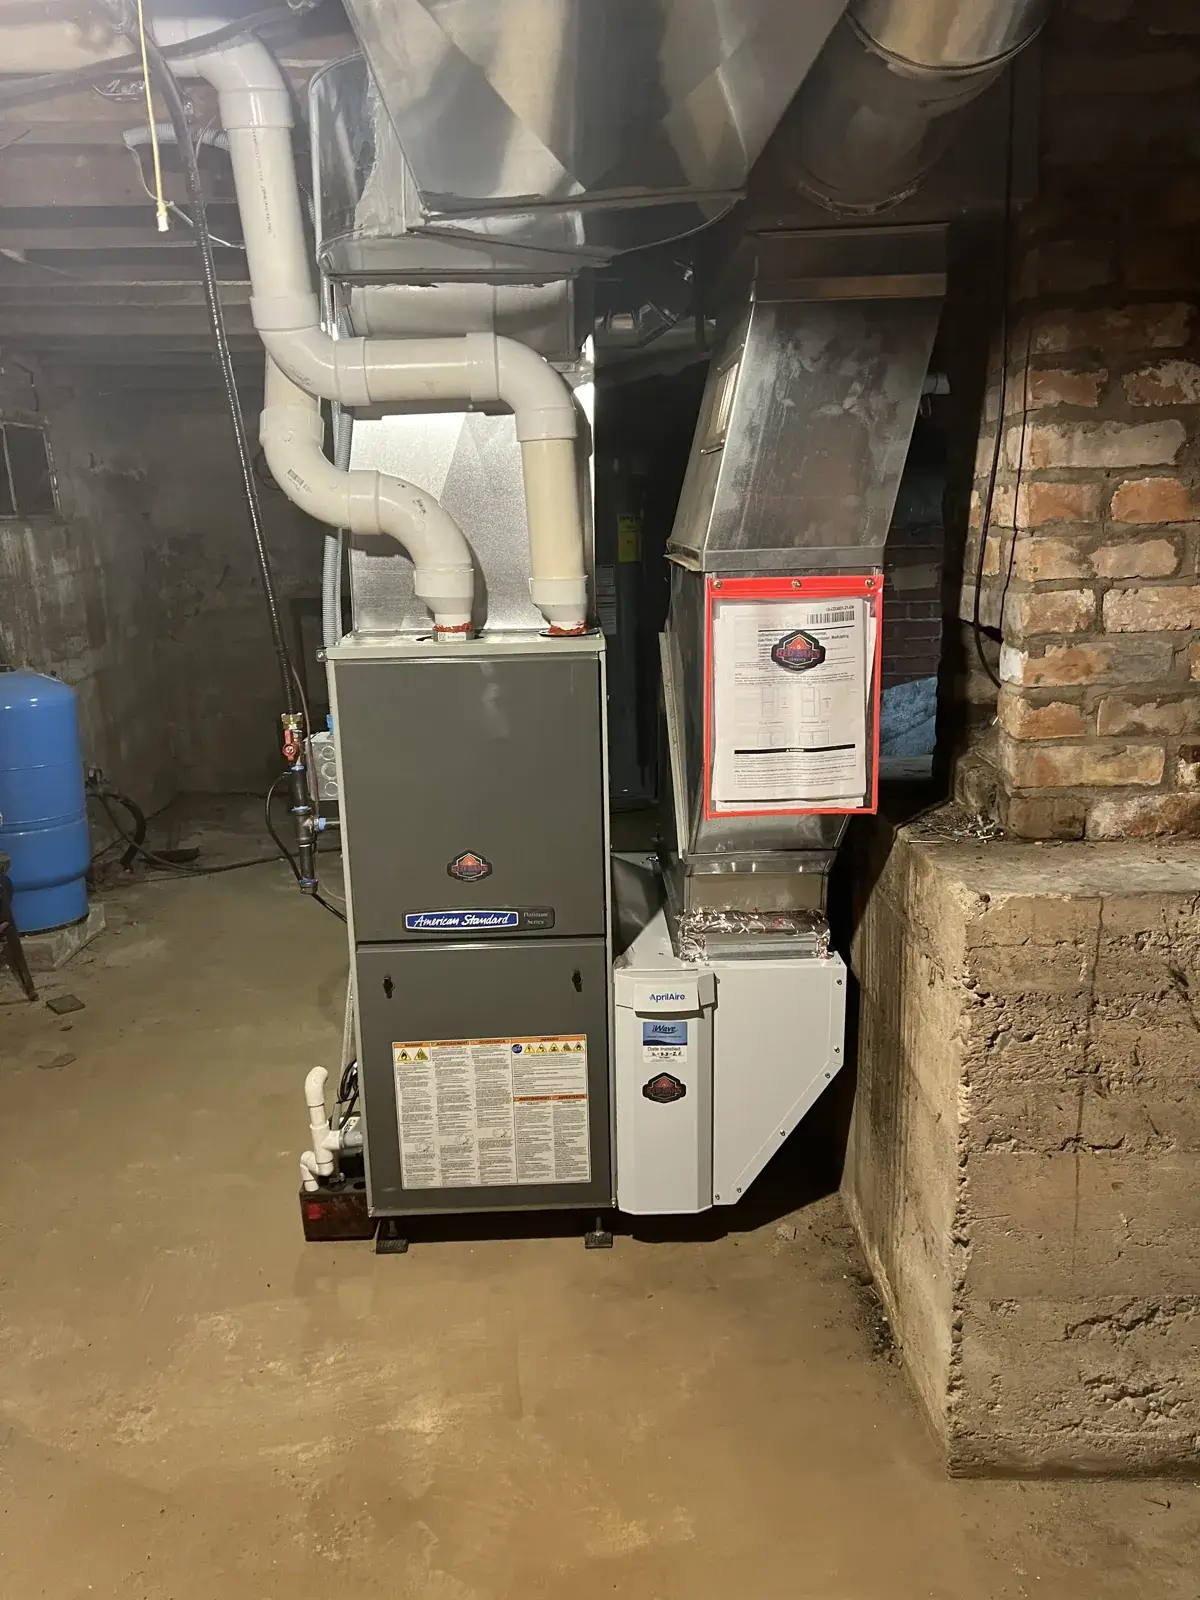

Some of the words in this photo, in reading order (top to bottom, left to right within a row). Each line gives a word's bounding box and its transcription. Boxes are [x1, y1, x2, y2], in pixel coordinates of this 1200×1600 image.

[414, 915, 459, 927] American
[461, 913, 510, 926] Standard
[649, 993, 686, 1003] AprilAire
[652, 1024, 677, 1032] iWave
